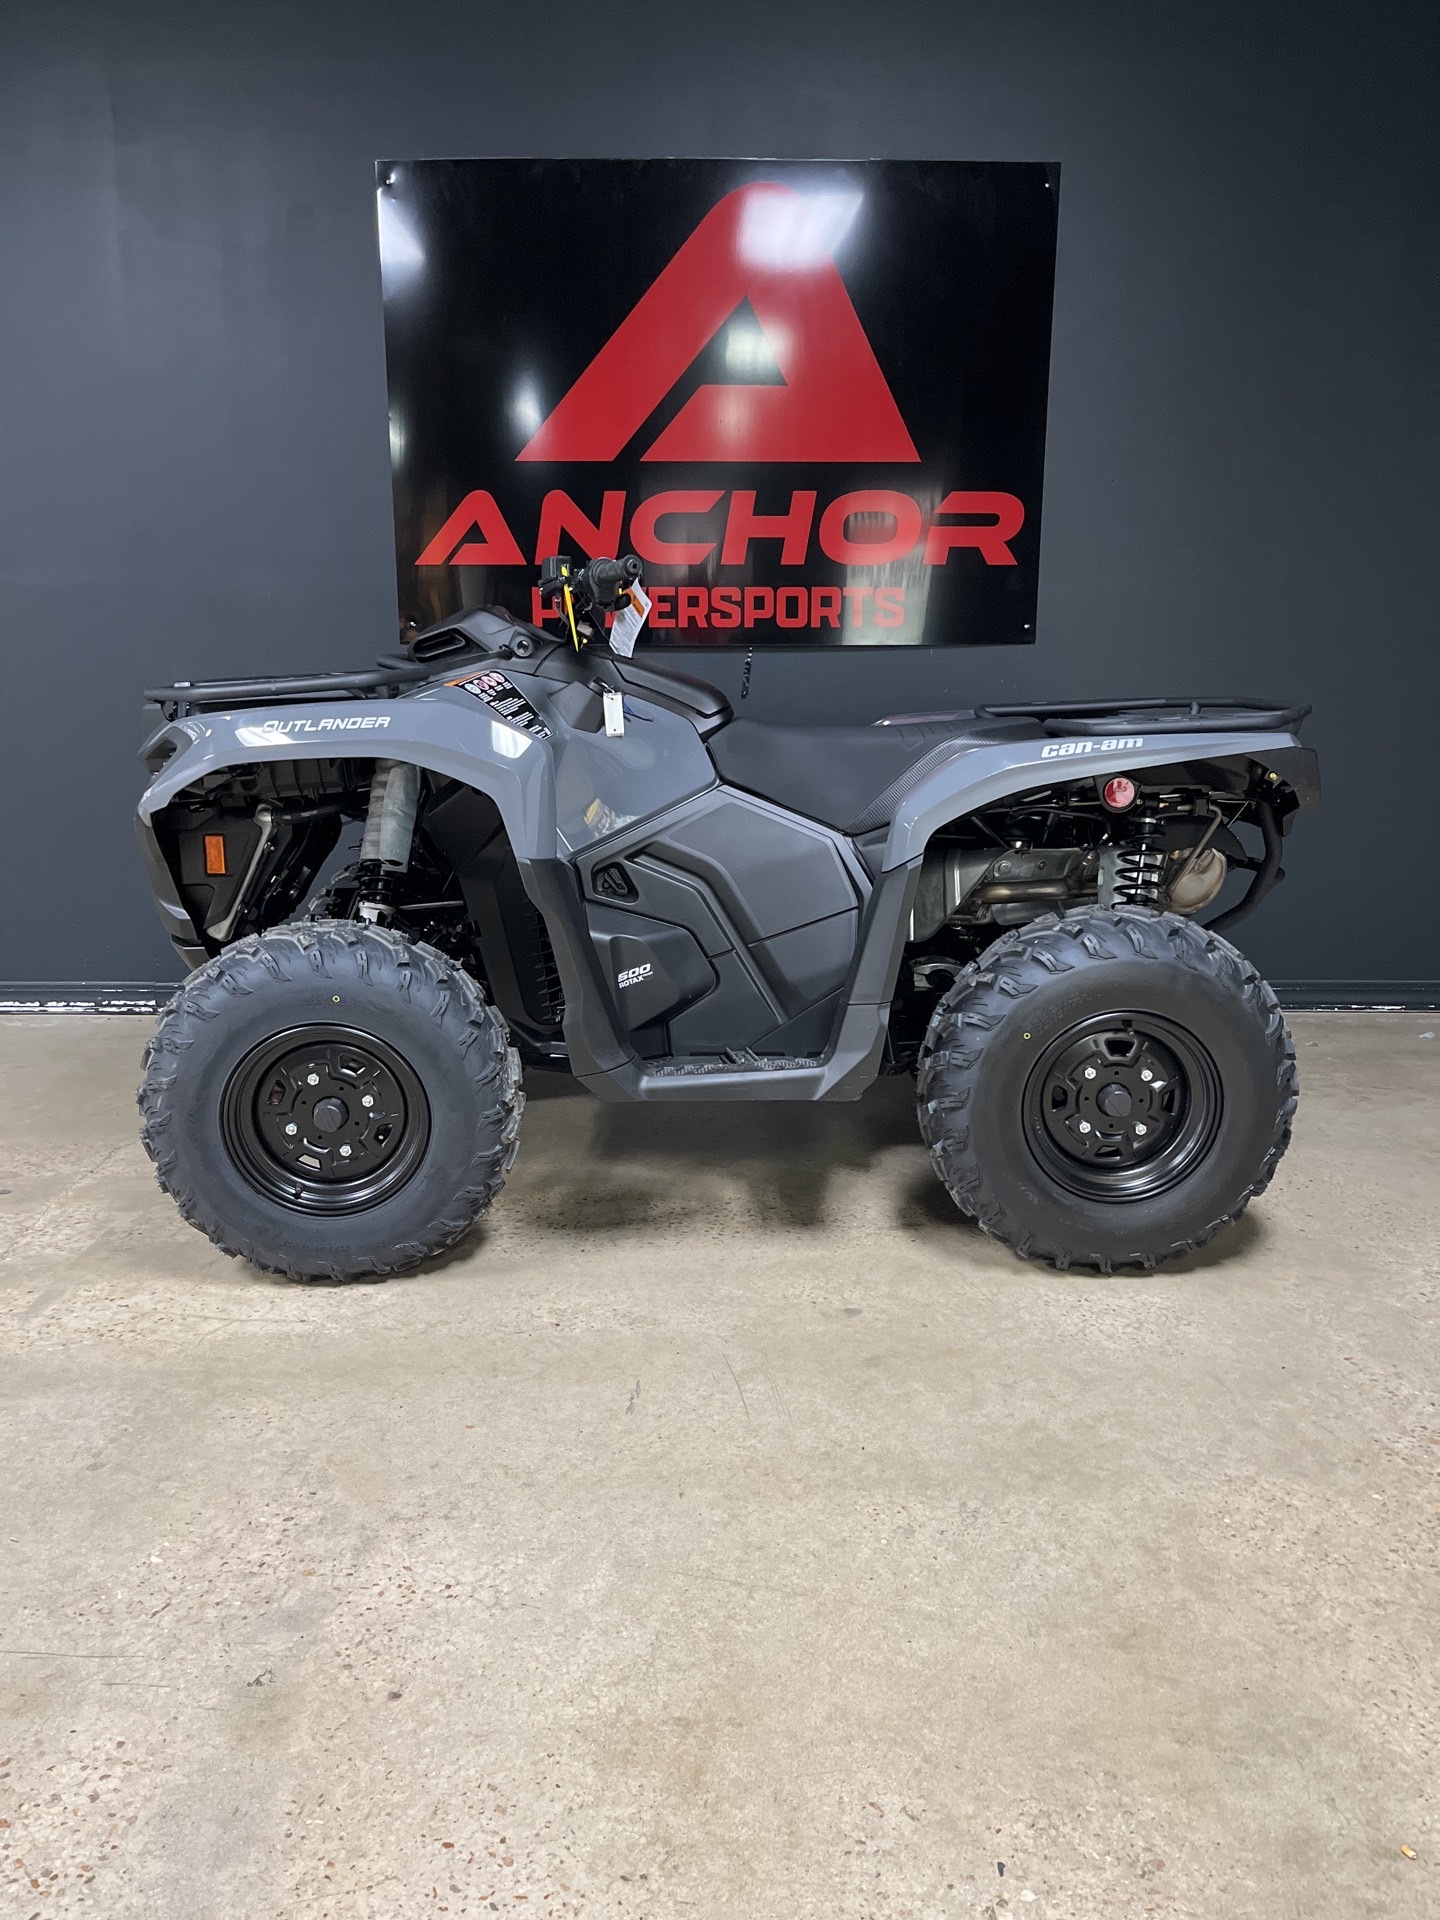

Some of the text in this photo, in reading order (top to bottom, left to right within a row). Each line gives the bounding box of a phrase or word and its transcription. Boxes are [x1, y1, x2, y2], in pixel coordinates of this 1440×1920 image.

[414, 489, 1026, 567] ANCHOR
[531, 586, 906, 629] PERSPORTS
[262, 716, 391, 734] OUTLANDER
[1041, 737, 1144, 758] can-am
[618, 975, 644, 989] ROTAX
